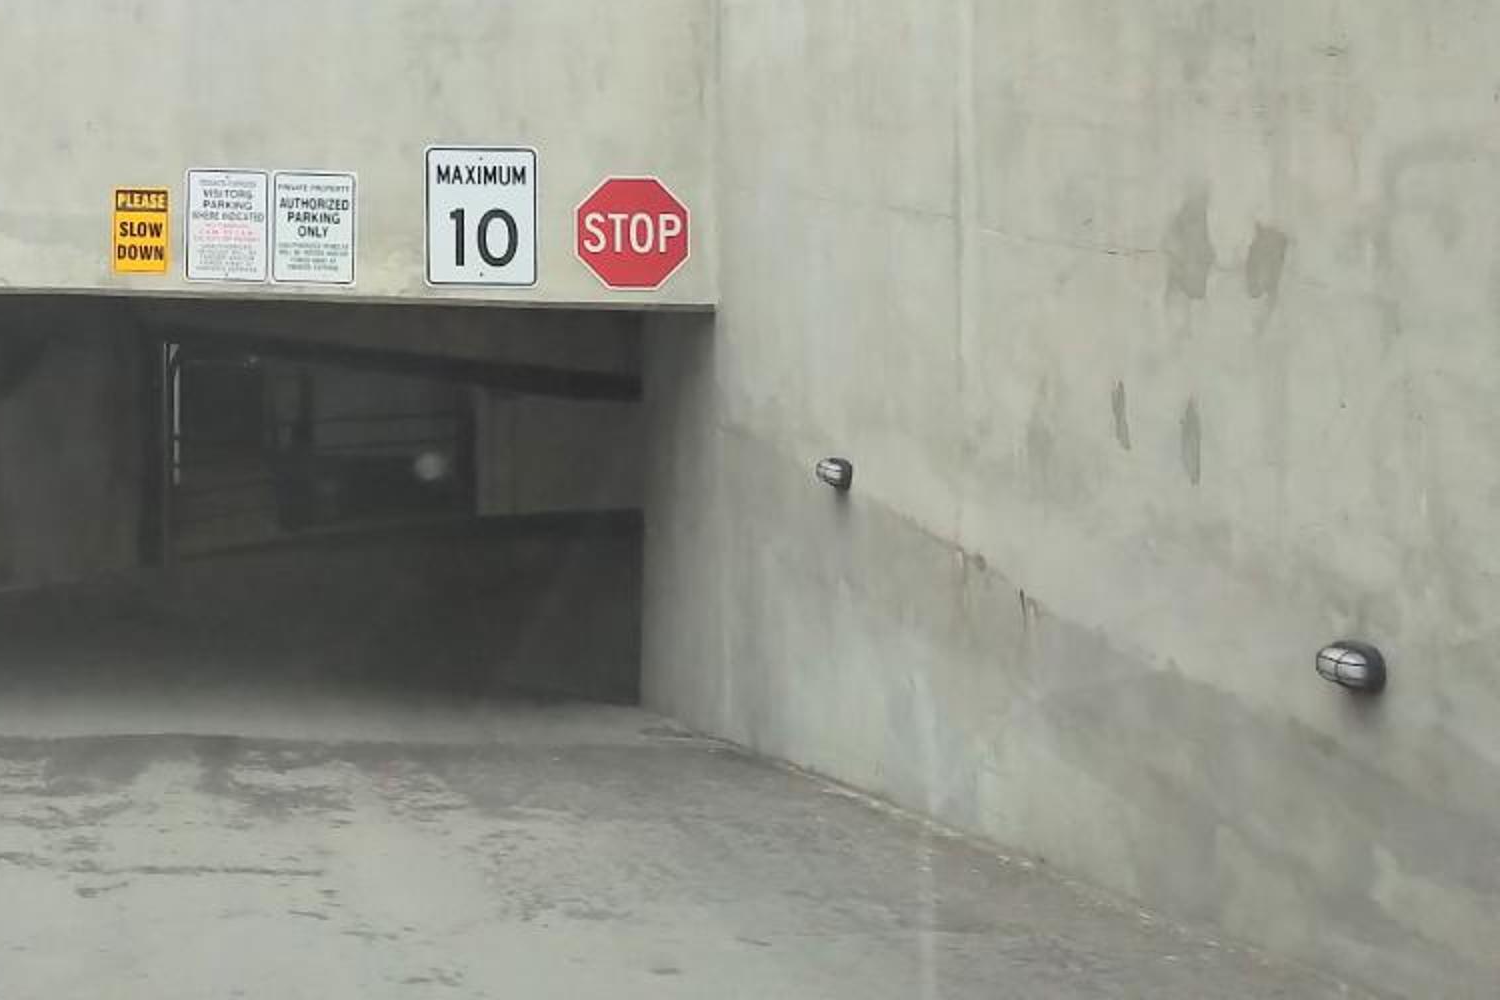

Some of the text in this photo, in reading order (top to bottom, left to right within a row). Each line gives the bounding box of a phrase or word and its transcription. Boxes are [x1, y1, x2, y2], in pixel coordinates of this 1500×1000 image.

[437, 165, 527, 185] MAXIMUM
[117, 193, 165, 210] PLEASE
[203, 189, 253, 200] VISITORS
[203, 200, 253, 210] PARKING
[279, 197, 350, 211] AUTHORIZED
[287, 211, 341, 225] PARKING
[119, 221, 163, 238] SLOW
[297, 225, 329, 238] ONLY
[449, 207, 519, 267] 10
[583, 212, 681, 254] STOP
[117, 245, 164, 261] DOWN
